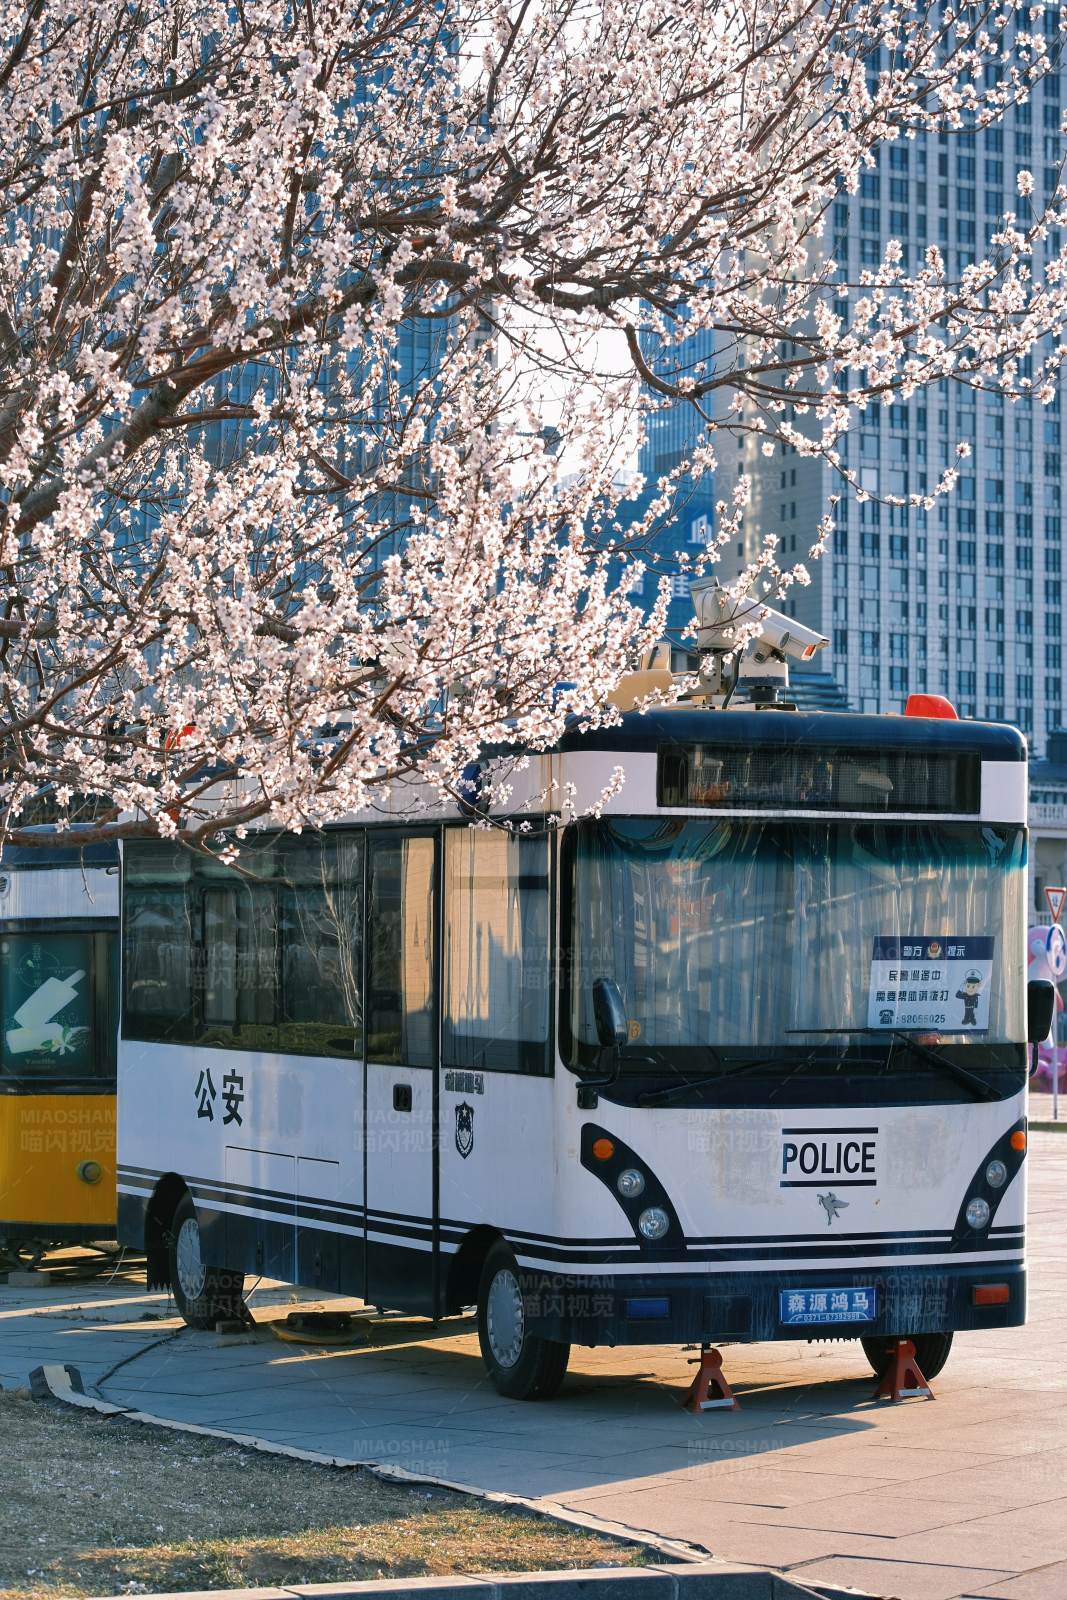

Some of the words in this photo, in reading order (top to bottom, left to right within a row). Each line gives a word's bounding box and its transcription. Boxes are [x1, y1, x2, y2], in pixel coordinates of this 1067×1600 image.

[194, 1067, 245, 1128] 公安
[782, 1141, 876, 1174] POLICE
[788, 1292, 869, 1312] 森源鸿马
